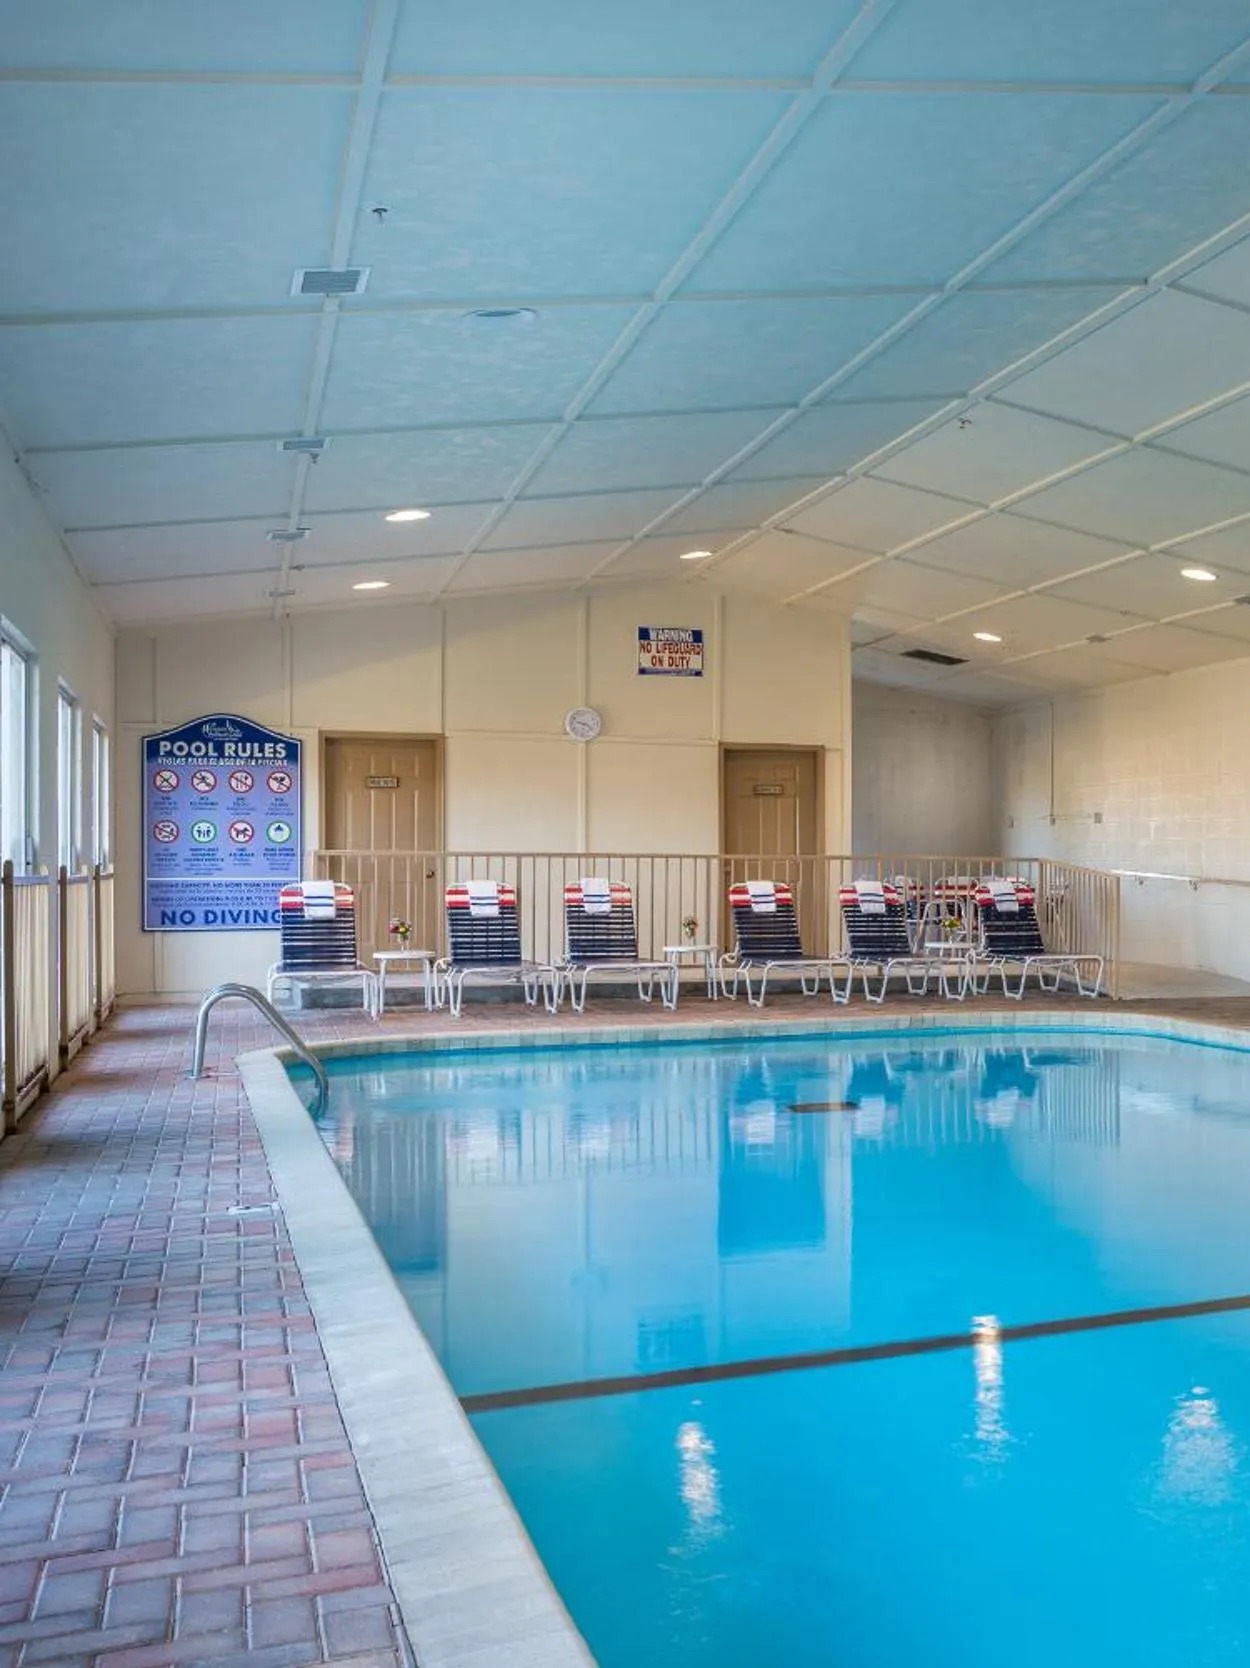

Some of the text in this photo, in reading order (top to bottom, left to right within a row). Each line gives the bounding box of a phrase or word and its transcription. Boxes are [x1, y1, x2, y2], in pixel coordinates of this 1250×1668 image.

[649, 629, 692, 642] WARNING
[640, 642, 703, 655] NO LIFEGUARD
[651, 655, 690, 667] ON DUTY
[159, 741, 287, 758] POOL RULES
[161, 909, 282, 925] NO DIVING
